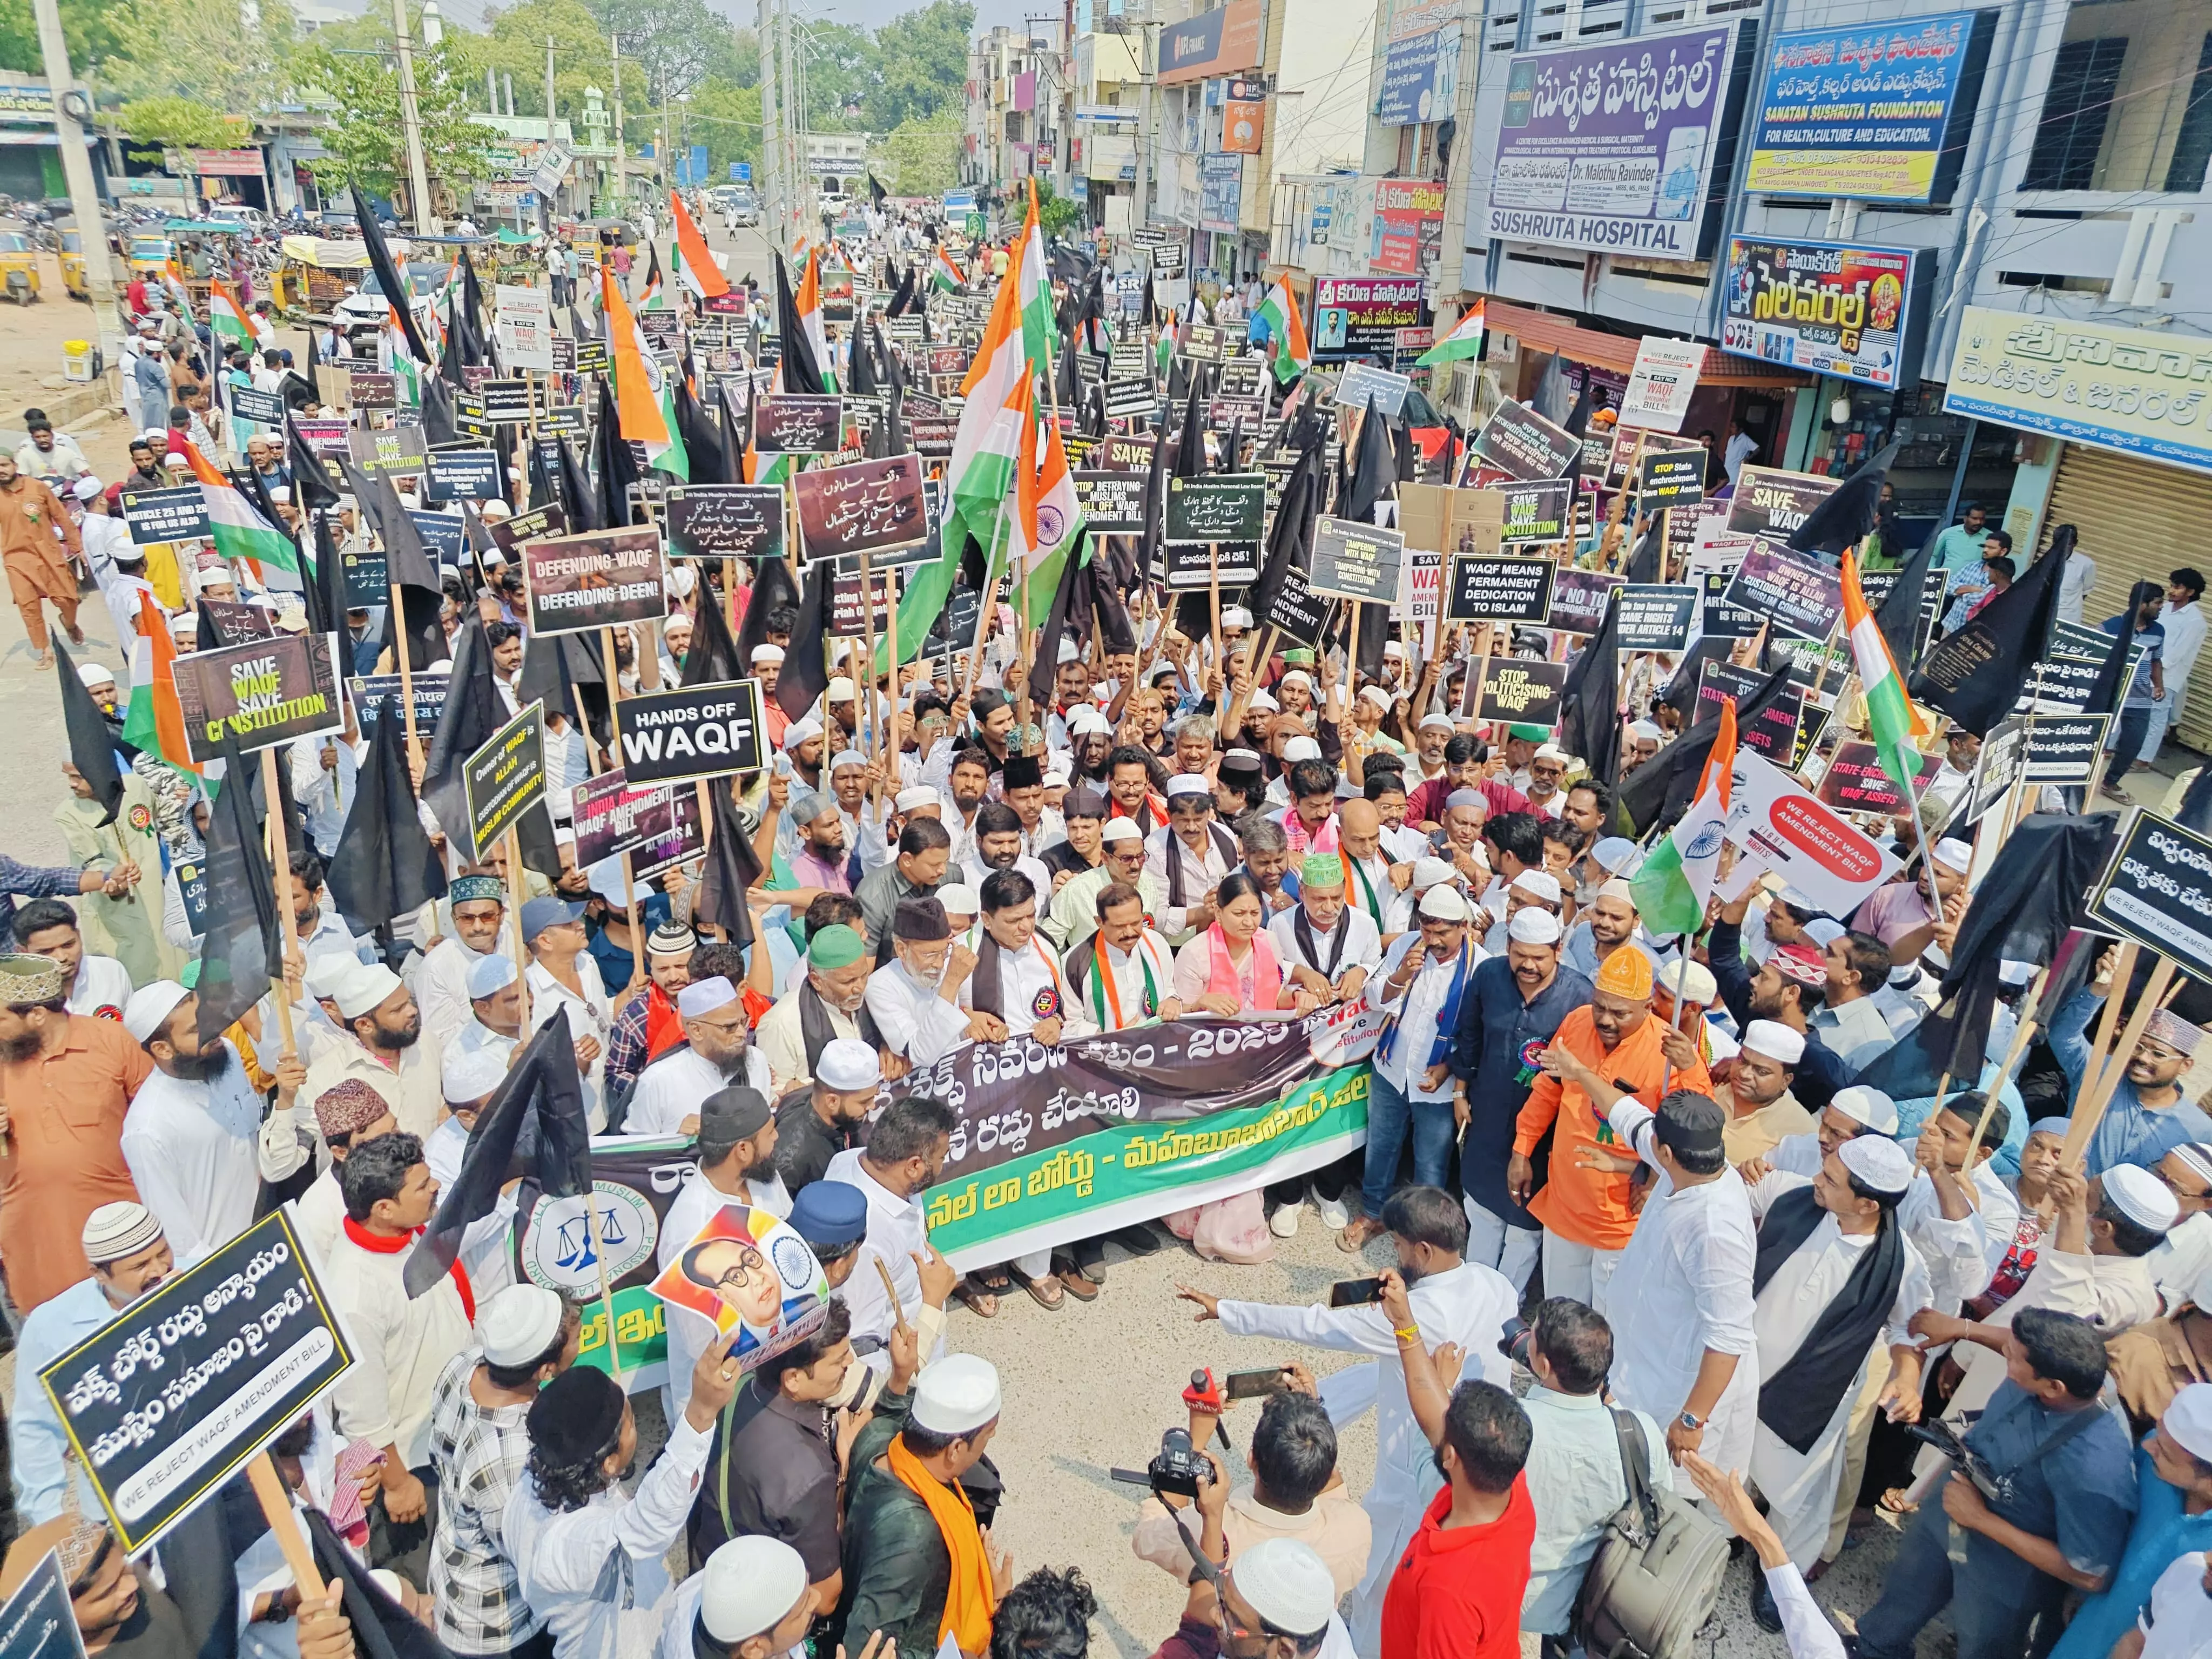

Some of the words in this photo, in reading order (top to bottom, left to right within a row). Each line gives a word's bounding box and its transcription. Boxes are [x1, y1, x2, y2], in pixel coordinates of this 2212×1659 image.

[1189, 35, 1205, 54] FINANCE
[1765, 106, 1807, 123] SANATAN
[1810, 103, 1865, 121] SUSHRUTA
[1867, 100, 1945, 119] FOUNDATION
[1765, 129, 1781, 143] FOR
[1854, 128, 1873, 142] AND
[1874, 127, 1931, 142] EDUCATION.
[1610, 146, 1631, 154] PROTOCAL
[1631, 145, 1657, 154] GUIDELINES
[1573, 164, 1582, 180] Dr.
[1586, 164, 1617, 180] Malothu
[1619, 164, 1656, 181] Ravinder
[1491, 211, 1575, 240] SUSHRUTA
[1579, 219, 1680, 250] HOSPITAL
[1319, 281, 1334, 305] శ్రీ
[1337, 284, 1370, 301] కరుణ
[1663, 353, 1690, 362] REJECT
[1814, 360, 1829, 368] vivo
[1647, 382, 1675, 396] WAQF
[1958, 353, 2066, 398] మెడికల్
[2062, 380, 2080, 404] &
[2085, 381, 2207, 426] జనరల్
[1643, 402, 1664, 411] BILL!
[375, 435, 398, 445] SAVE
[868, 470, 900, 486] وقف
[1654, 464, 1674, 473] STOP
[1674, 462, 1692, 471] State
[1074, 482, 1093, 491] STOP
[1096, 480, 1141, 491] BETRAYING
[1649, 473, 1697, 485] enchrochment
[1090, 491, 1127, 502] MUSLIMS
[1223, 495, 1249, 505] وقف
[1641, 488, 1658, 498] Save
[1658, 486, 1679, 496] WAQF
[1680, 484, 1702, 494] Assets
[127, 509, 160, 522] ARTICLE
[161, 508, 176, 518] 25
[177, 507, 197, 517] AND
[197, 504, 208, 515] 26
[1098, 501, 1114, 511] OFF
[1116, 501, 1139, 511] WAQF
[141, 521, 150, 530] IS
[151, 519, 166, 530] FOR
[167, 518, 179, 529] US
[180, 516, 200, 527] ALSO
[1344, 548, 1359, 558] WITH
[1360, 549, 1375, 562] WAQF
[1346, 539, 1377, 554] TAMPERING
[535, 552, 612, 578] DEFENDING
[615, 548, 653, 570] WAQF
[1334, 561, 1366, 575] TAMPERING
[1367, 567, 1381, 578] WITH
[1465, 564, 1499, 575] WAQF
[1501, 564, 1543, 576] MEANS
[1337, 570, 1375, 585] CONSTITUTION
[1467, 577, 1540, 589] PERMANENT
[1778, 564, 1807, 584] OWNER
[1809, 575, 1822, 586] OF
[538, 586, 615, 611] DEFENDING
[619, 582, 659, 602] DEEN!
[1465, 588, 1536, 601] DEDICATION
[1743, 575, 1787, 600] CUSTODIAN
[1787, 590, 1799, 602] OF
[1799, 595, 1824, 615] WAQF
[1825, 608, 1835, 618] IS
[1766, 571, 1791, 589] WAQF
[1791, 578, 1799, 591] IS
[1800, 582, 1826, 602] ALLAH
[1473, 602, 1491, 612] TO
[1493, 602, 1527, 614] ISLAM
[1745, 587, 1777, 610] MUSLIM
[1777, 601, 1826, 625] COMMUNITY
[230, 656, 276, 679] SAVE
[1499, 669, 1529, 684] STOP
[231, 671, 281, 696] WAQF
[238, 692, 282, 715] SAVE
[1497, 694, 1529, 711] WAQF
[636, 705, 699, 727] HANDS
[702, 702, 737, 718] OFF
[622, 718, 753, 764] WAQF
[476, 754, 497, 782] Owner
[497, 746, 506, 761] of
[505, 728, 528, 753] WAQF
[495, 756, 518, 784] ALLAH
[477, 786, 507, 822] CUSTODIAN
[514, 766, 530, 786] WAQF
[476, 810, 503, 845] MUSLIM
[502, 771, 543, 818] COMMUNITY
[1777, 811, 1843, 862] AMENDMENT
[1841, 857, 1863, 877] BILL
[1785, 801, 1804, 817] WE
[1801, 812, 1841, 844] REJECT
[1840, 841, 1876, 869] WAQF
[2108, 892, 2122, 905] WE
[2122, 901, 2156, 923] REJECT
[2155, 920, 2182, 938] WAQF
[977, 1108, 1033, 1154] రద్దు
[1040, 1086, 1141, 1131] చేయాలి
[983, 1177, 1021, 1211] లా
[1026, 1149, 1096, 1198] బోర్డు
[594, 1181, 646, 1210] MUSLIM
[532, 1199, 550, 1228] ALL
[604, 1236, 655, 1287] PERSONA
[65, 1363, 122, 1414] వక్ఫ్
[159, 1303, 207, 1346] రద్దు
[203, 1242, 290, 1315] అన్యాయం
[87, 1401, 166, 1467] ముస్లిం
[161, 1335, 245, 1407] సమాజం
[244, 1321, 269, 1359] పై
[260, 1277, 315, 1335] దాడి!
[122, 1483, 147, 1509] WE
[146, 1444, 196, 1490] REJECT
[195, 1412, 233, 1449] WAQF
[233, 1359, 302, 1423] AMENDMENT
[302, 1338, 327, 1364] BILL
